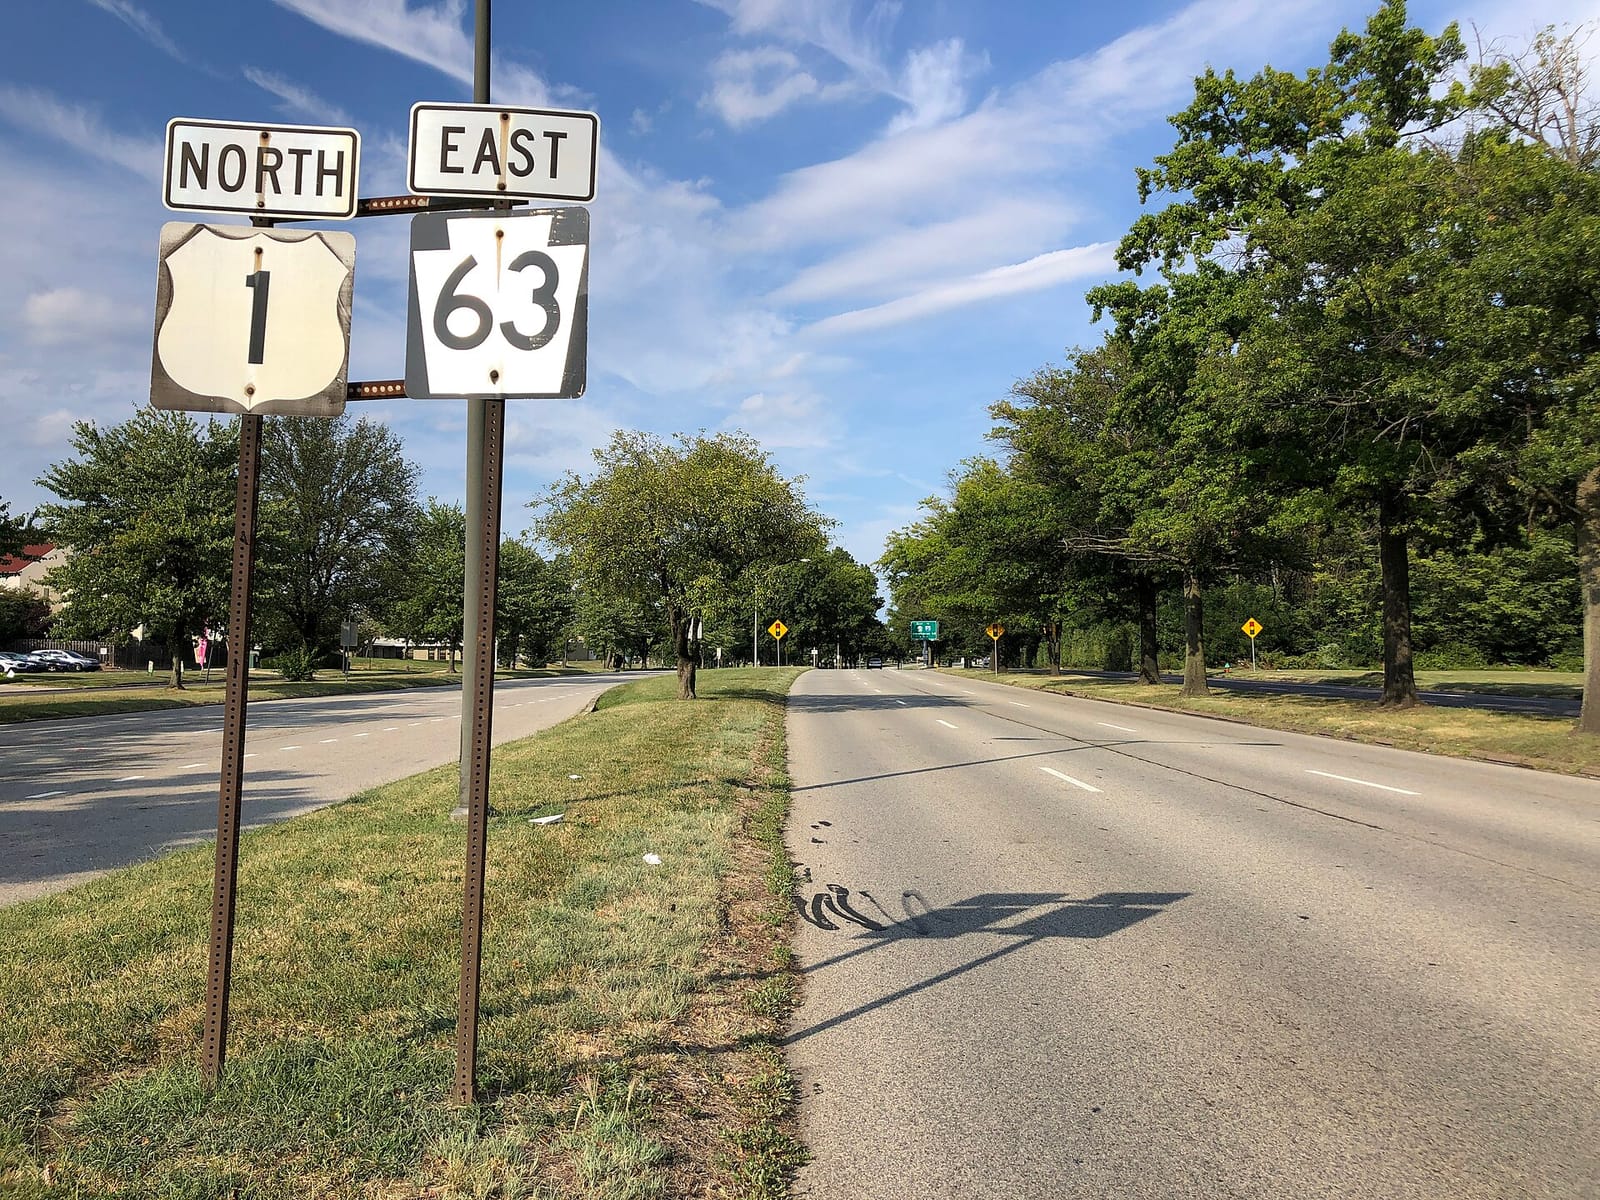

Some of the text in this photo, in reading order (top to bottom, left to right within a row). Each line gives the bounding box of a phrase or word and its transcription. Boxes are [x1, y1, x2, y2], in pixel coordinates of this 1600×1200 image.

[179, 141, 345, 197] NORTH
[439, 126, 568, 179] EAST
[245, 270, 271, 365] 1
[433, 250, 561, 351] 63
